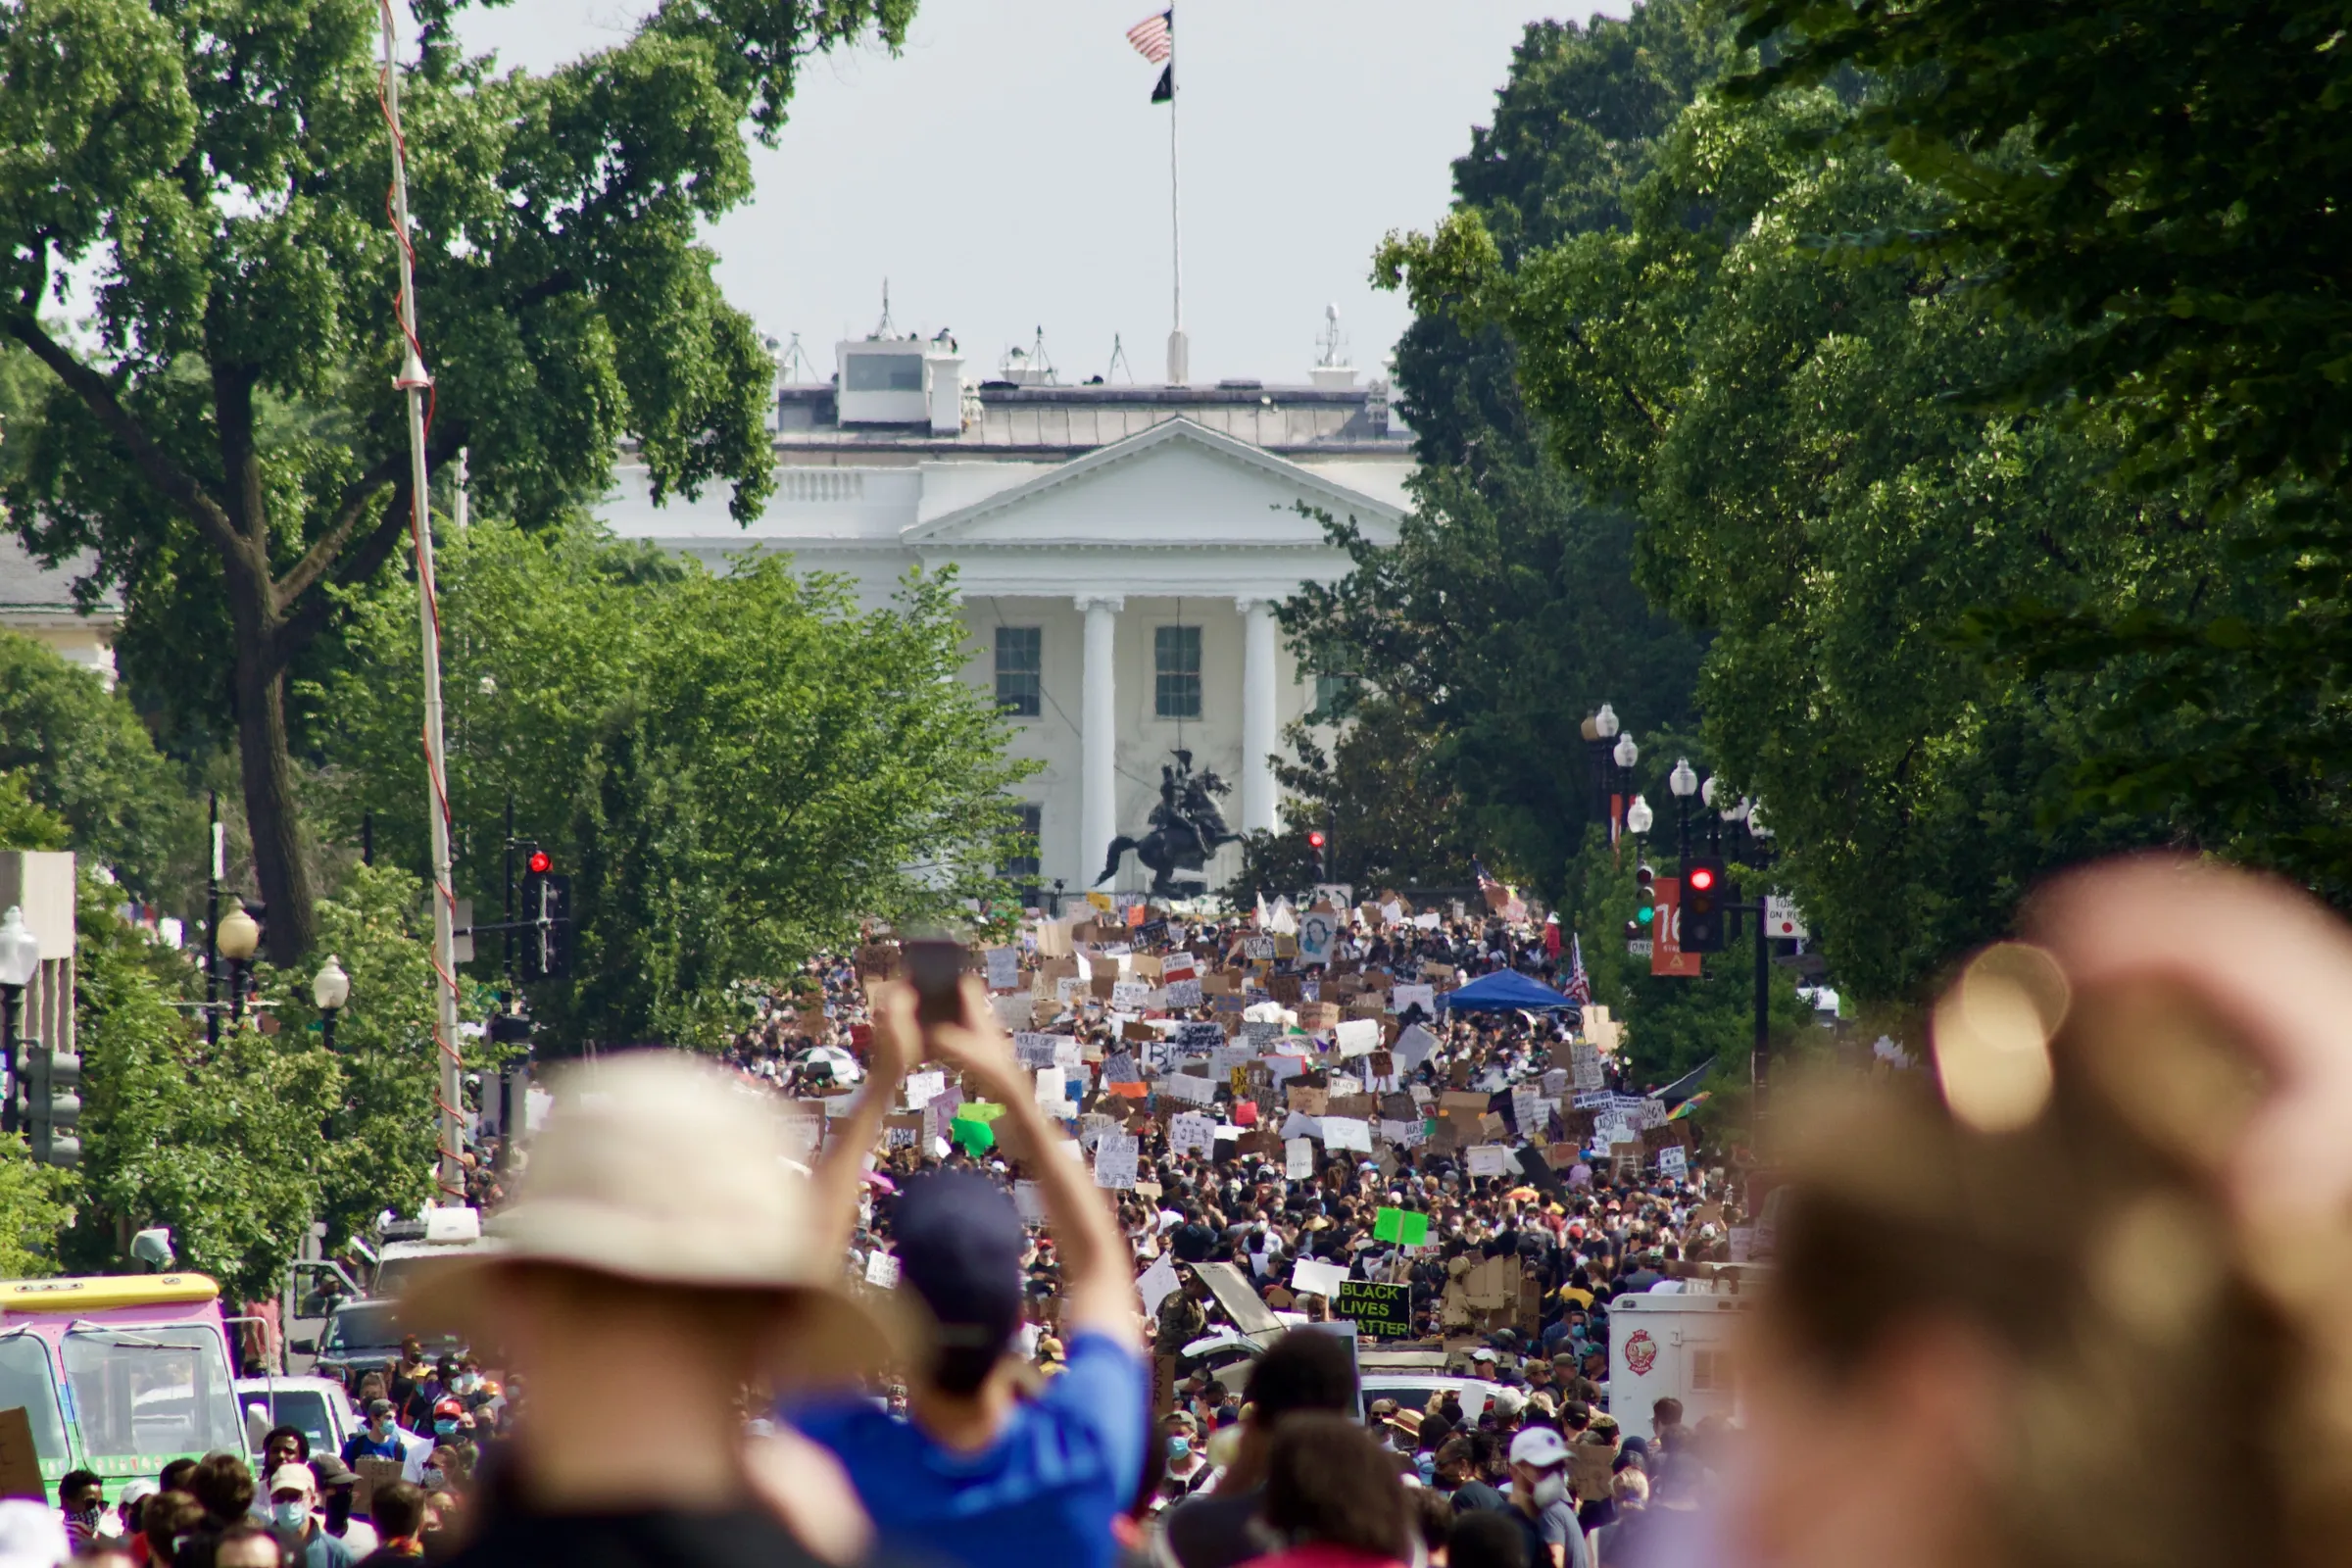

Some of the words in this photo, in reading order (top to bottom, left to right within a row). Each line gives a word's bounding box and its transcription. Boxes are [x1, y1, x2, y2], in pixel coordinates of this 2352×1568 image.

[1775, 898, 1792, 908] TUR
[1632, 942, 1651, 954] ONE
[1341, 1283, 1398, 1300] BLACK
[1341, 1299, 1390, 1316] LIVES
[1356, 1319, 1408, 1336] ATTER
